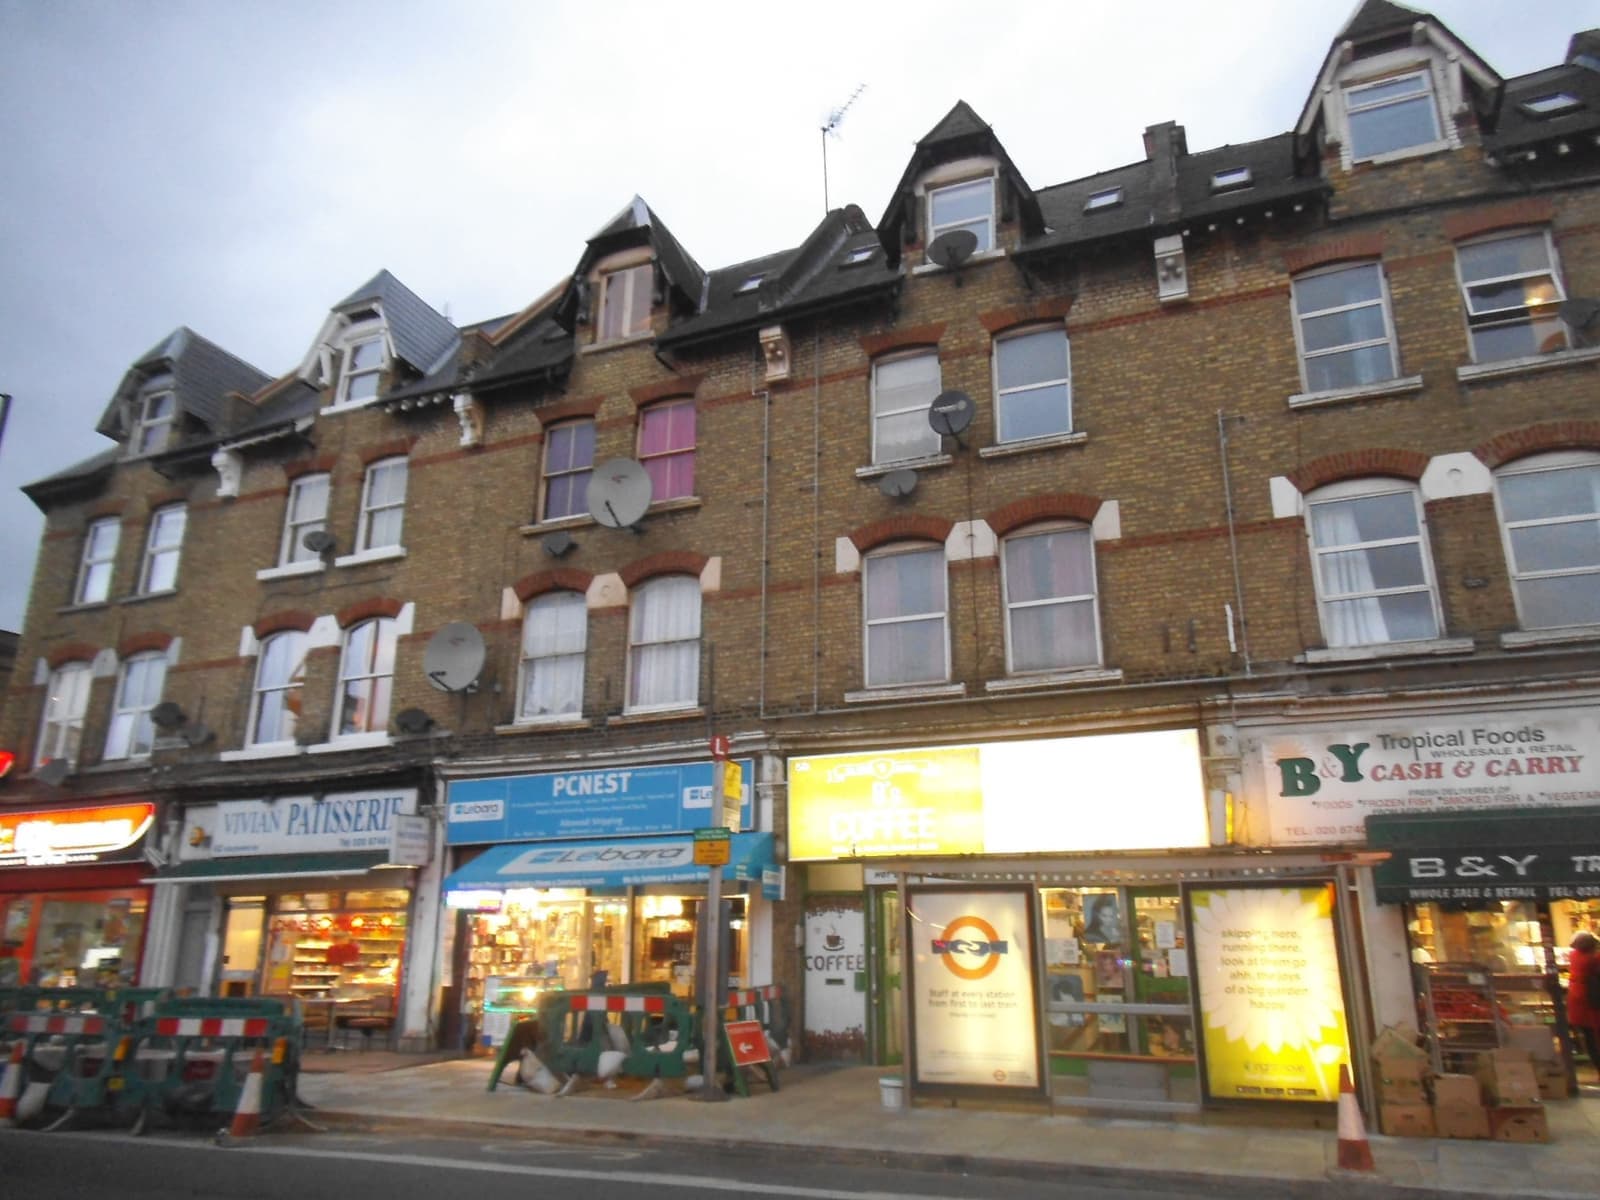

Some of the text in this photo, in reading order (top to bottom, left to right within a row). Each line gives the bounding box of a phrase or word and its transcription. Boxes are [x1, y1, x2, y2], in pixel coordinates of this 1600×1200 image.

[1376, 726, 1546, 760] Tropical Foods
[1430, 747, 1513, 759] WHOLESALE
[1528, 744, 1577, 754] RETAIL
[1370, 755, 1584, 782] CASH & CARRY
[552, 772, 632, 797] PCNEST
[224, 810, 281, 834] VIVIAN
[558, 846, 686, 864] Lebara
[804, 954, 865, 973] COFFEE
